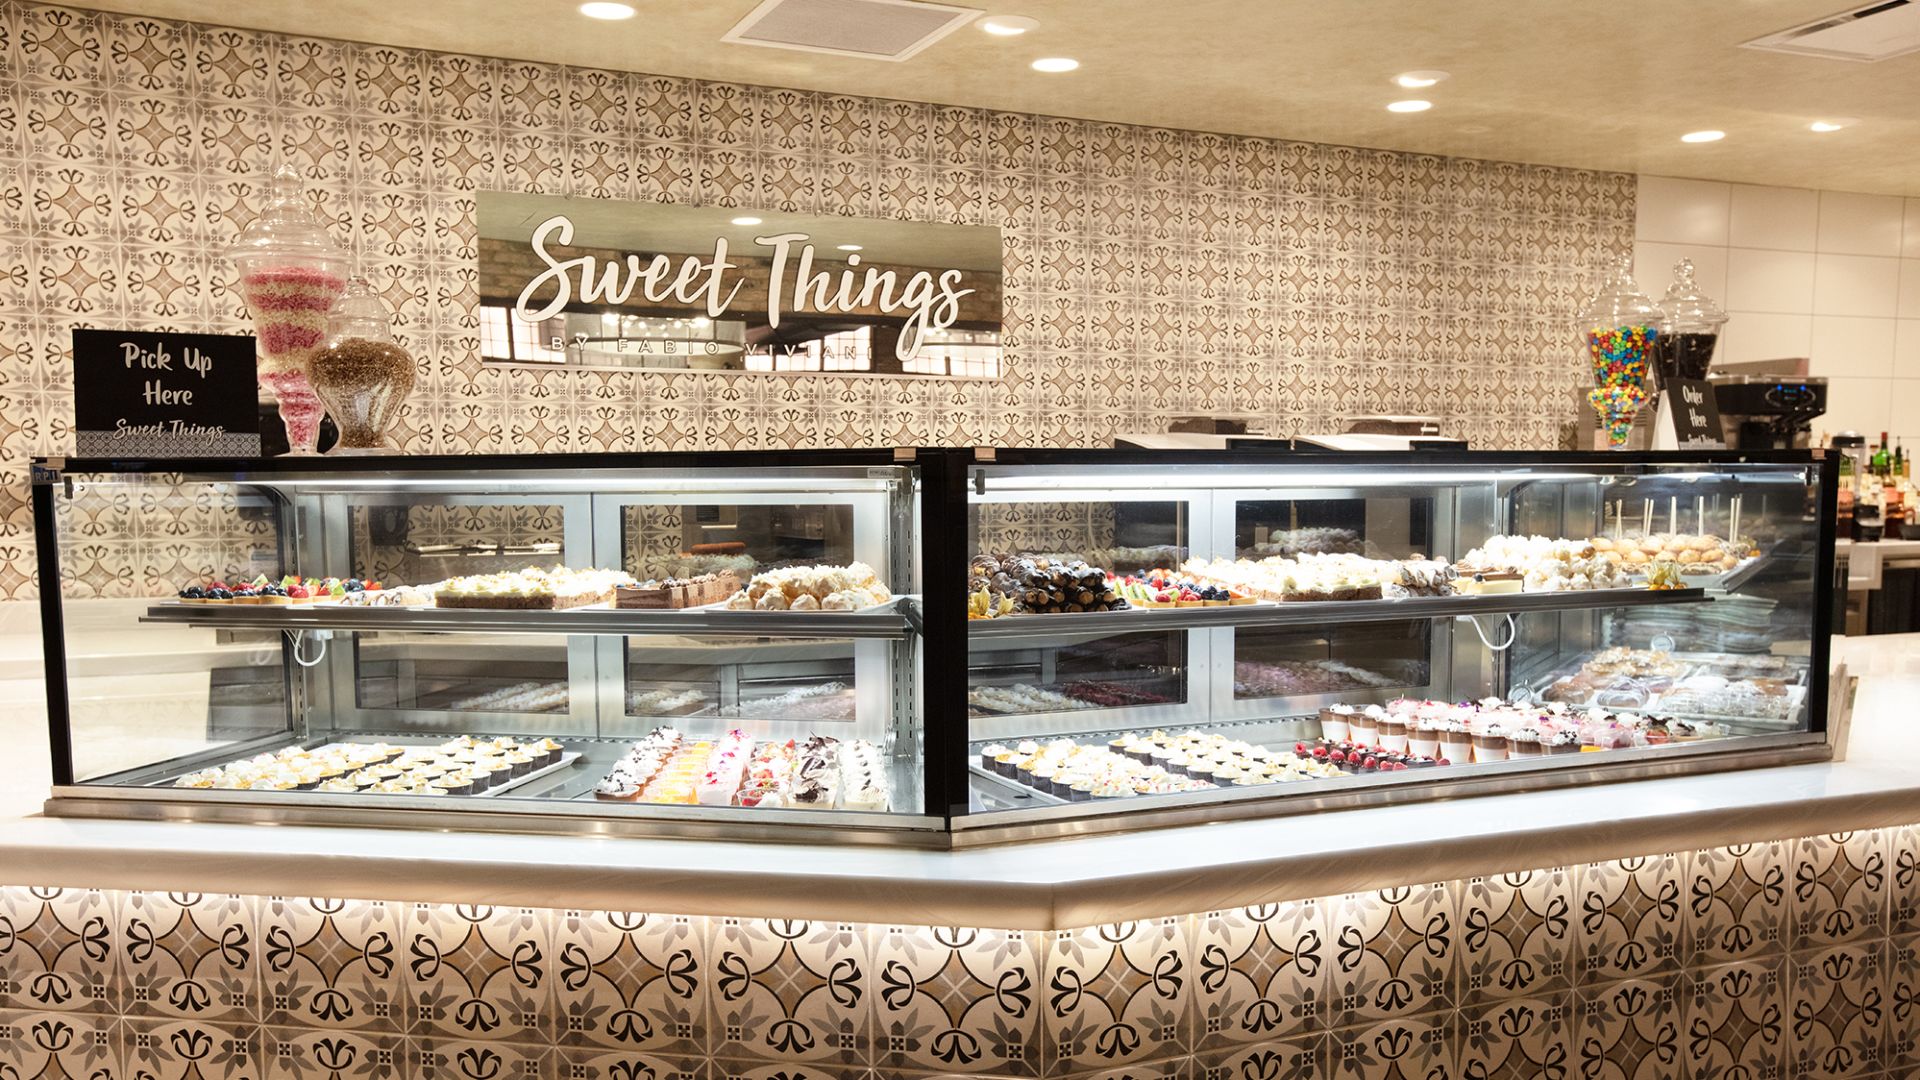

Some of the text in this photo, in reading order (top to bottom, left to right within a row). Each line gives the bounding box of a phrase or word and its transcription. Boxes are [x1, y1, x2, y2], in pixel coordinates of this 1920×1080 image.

[515, 214, 976, 362] Sweet Things
[119, 342, 212, 379] Pick Up
[551, 336, 873, 359] BY FABIO VIVIANI
[142, 379, 193, 405] Here
[1682, 385, 1703, 405] Order
[1689, 407, 1707, 427] Here
[113, 418, 225, 446] Sweet Things
